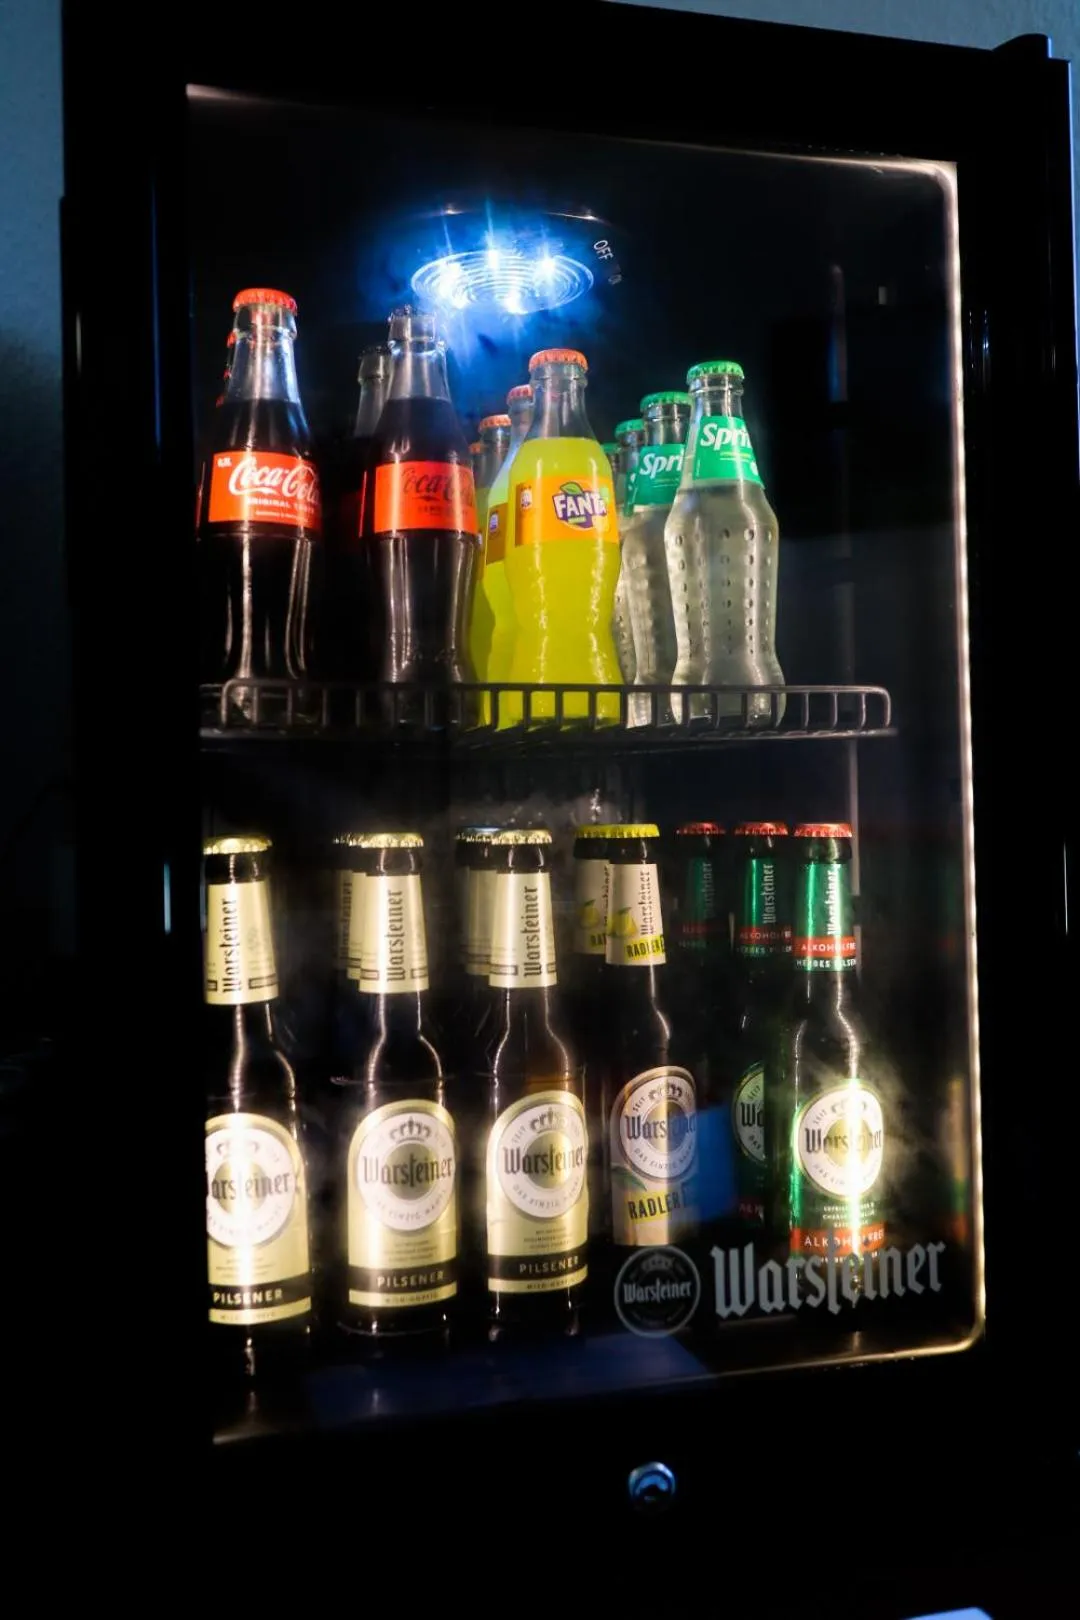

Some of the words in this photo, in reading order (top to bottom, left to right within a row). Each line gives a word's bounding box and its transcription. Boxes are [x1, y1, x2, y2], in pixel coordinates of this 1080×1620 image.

[593, 239, 614, 261] OFF
[760, 864, 776, 925] Warsteiner
[219, 897, 243, 994] Warsteiner
[385, 889, 407, 982] Warsteiner
[521, 886, 543, 978] Warsteiner
[363, 1152, 453, 1187] Warsteiner
[503, 1143, 584, 1176] Warsteiner
[206, 1170, 292, 1200] arsteiner
[628, 1192, 681, 1220] RADLER
[376, 1270, 444, 1289] PILSENER
[519, 1255, 579, 1274] PILSENER
[709, 1240, 946, 1320] Warsteiner
[212, 1288, 283, 1305] PILSENER
[623, 1277, 692, 1304] Warsteiner
